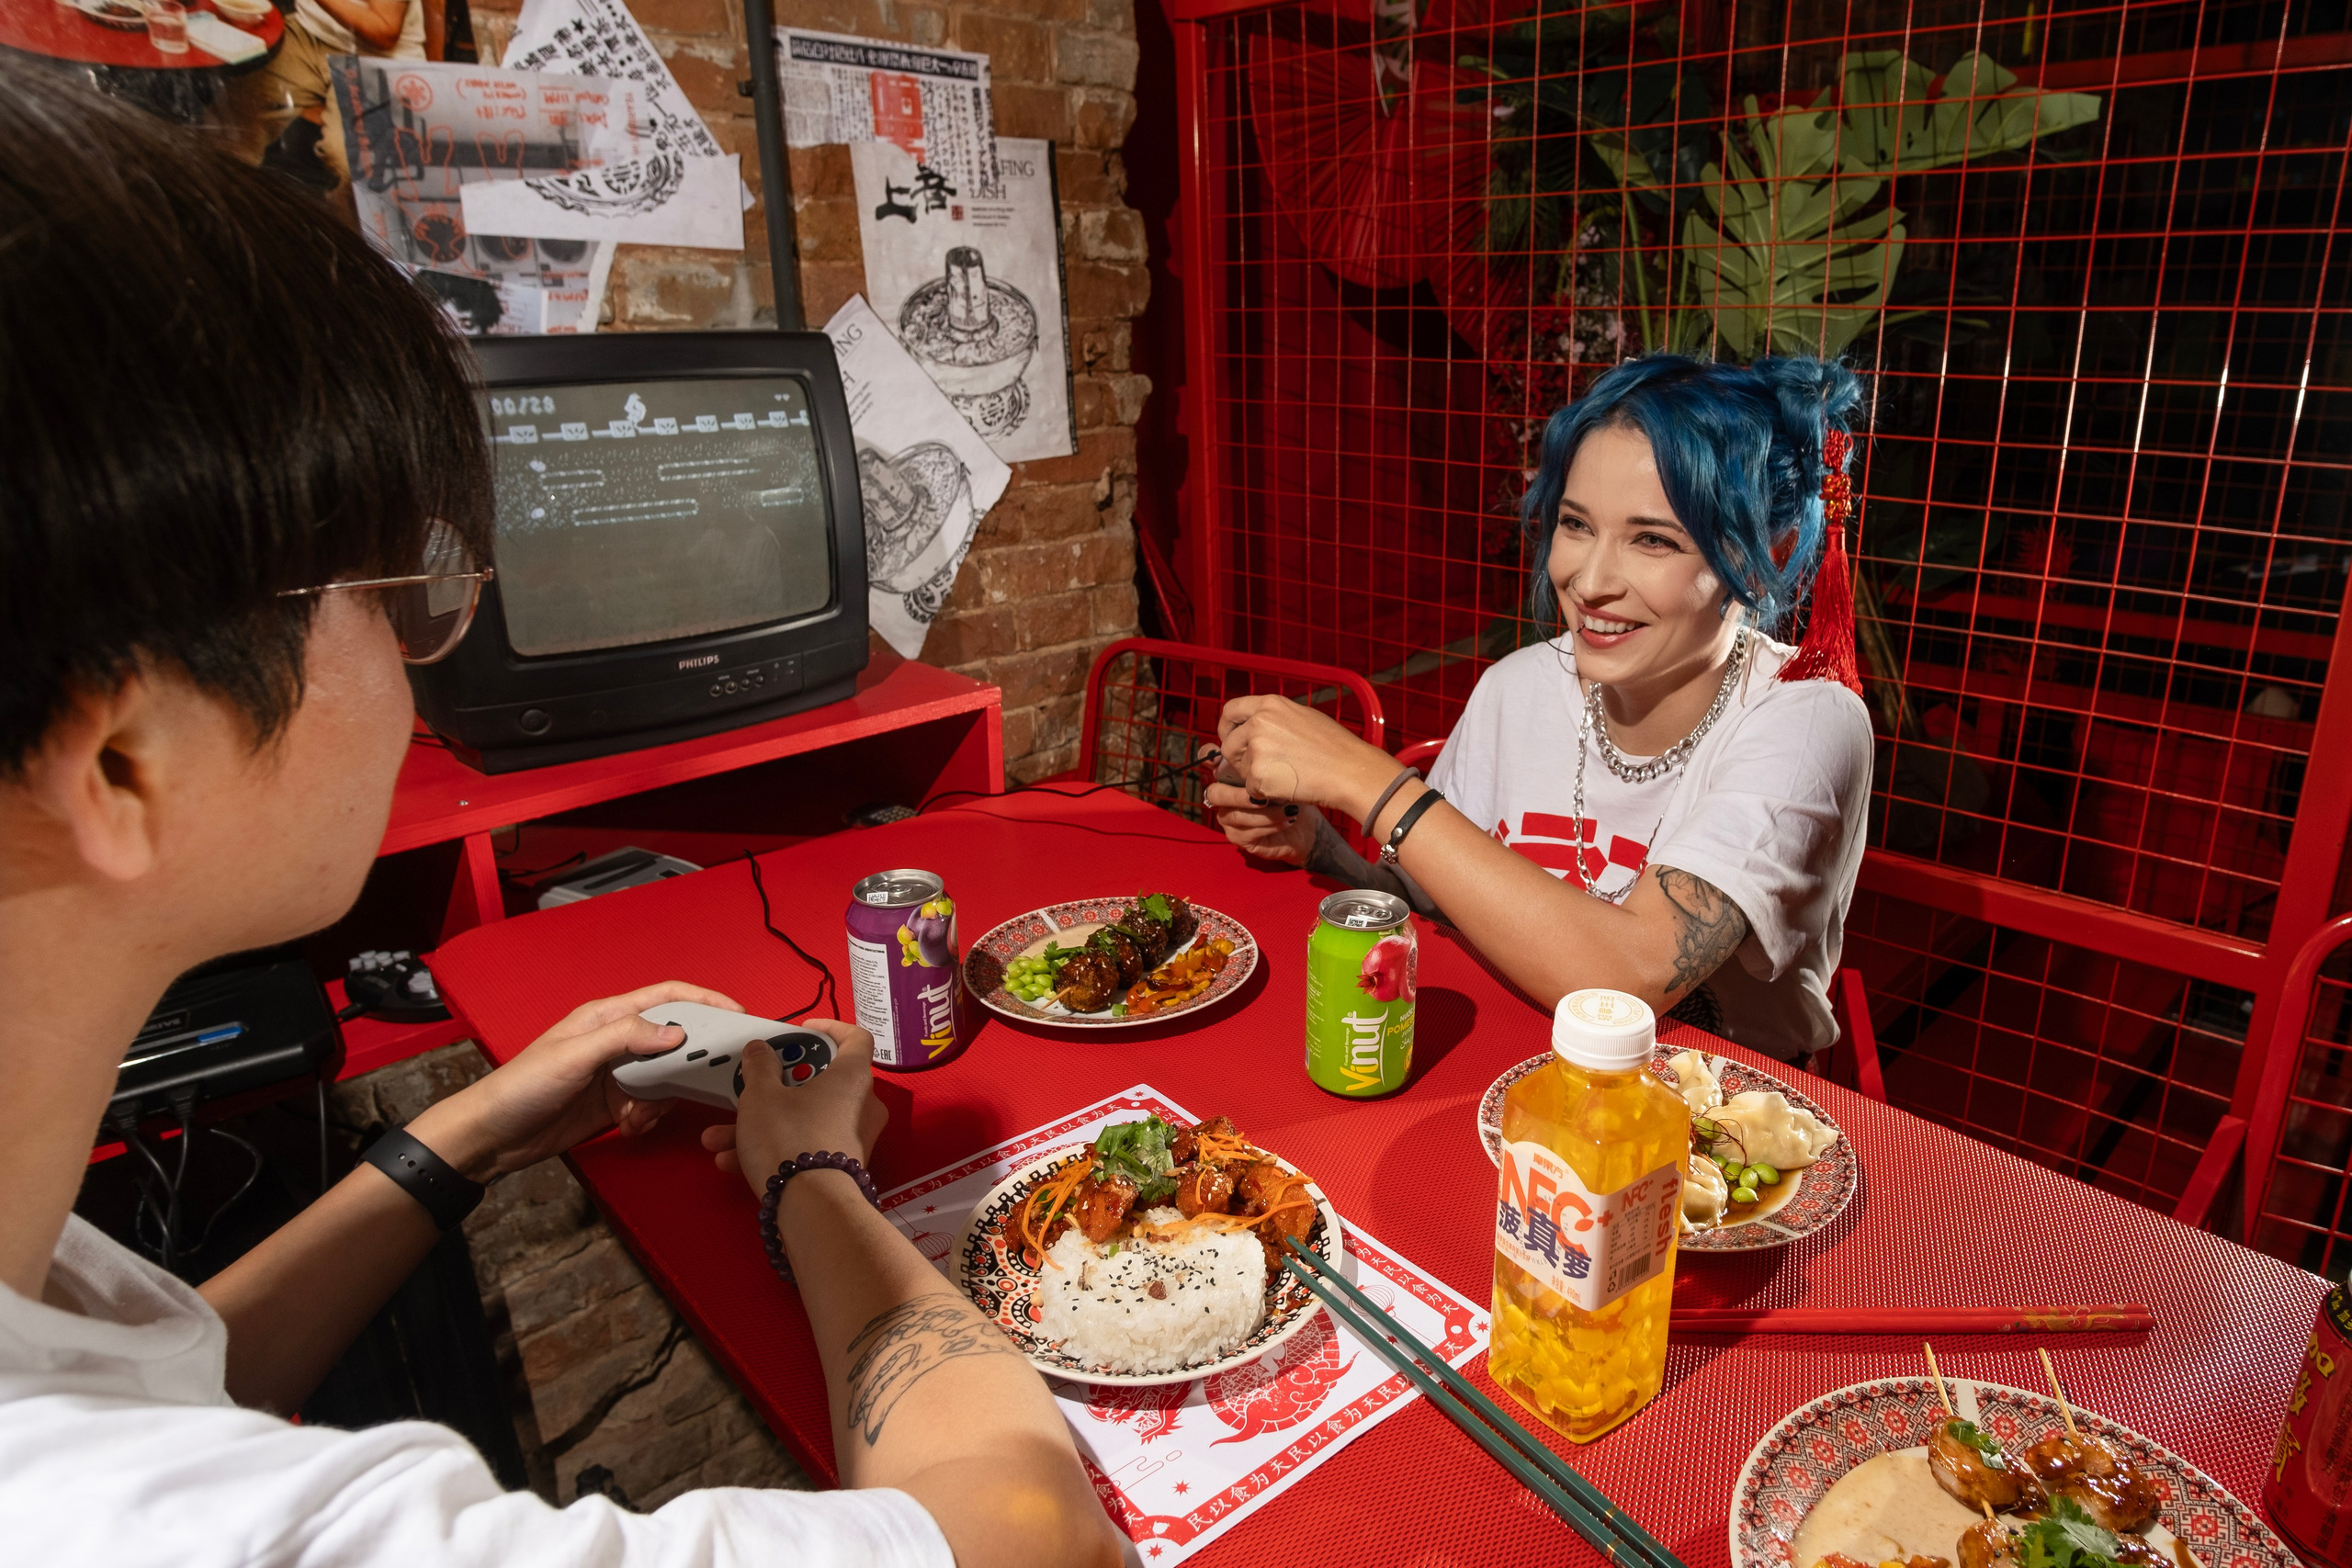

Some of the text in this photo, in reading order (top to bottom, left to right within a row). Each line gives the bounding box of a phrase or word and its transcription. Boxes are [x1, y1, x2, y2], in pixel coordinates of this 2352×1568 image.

[678, 654, 719, 671] PHILIPS
[917, 972, 955, 1059] Vinut
[1340, 1006, 1389, 1091] Vinut
[1501, 1148, 1594, 1258] NFC
[1621, 1179, 1649, 1212] NFC
[1656, 1177, 1679, 1257] flesh
